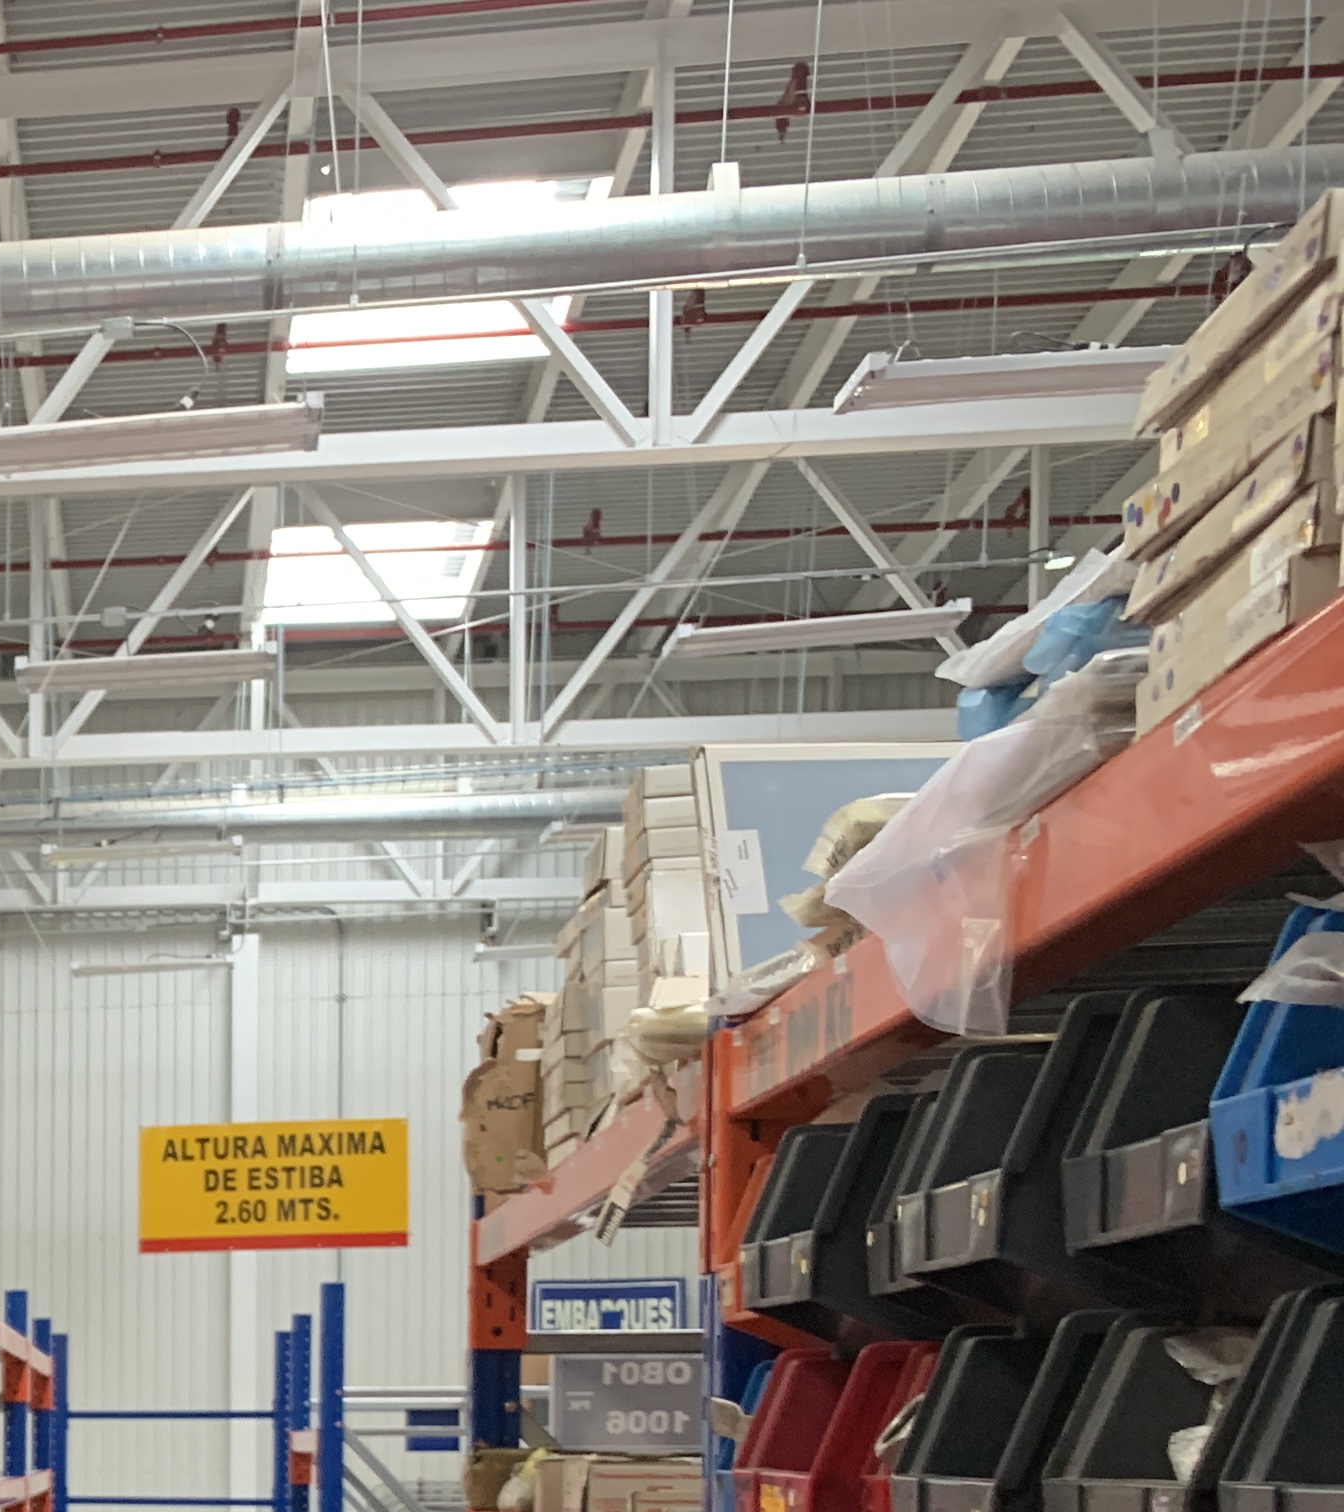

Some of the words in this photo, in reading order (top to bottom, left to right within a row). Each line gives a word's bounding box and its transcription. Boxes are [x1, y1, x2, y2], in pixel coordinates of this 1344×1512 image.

[162, 1135, 268, 1163] ALTURA
[276, 1131, 386, 1158] MAXIMA
[204, 1168, 237, 1193] DE
[247, 1164, 344, 1191] ESTIBA
[215, 1200, 267, 1225] 2.60
[276, 1197, 341, 1223] MTS.
